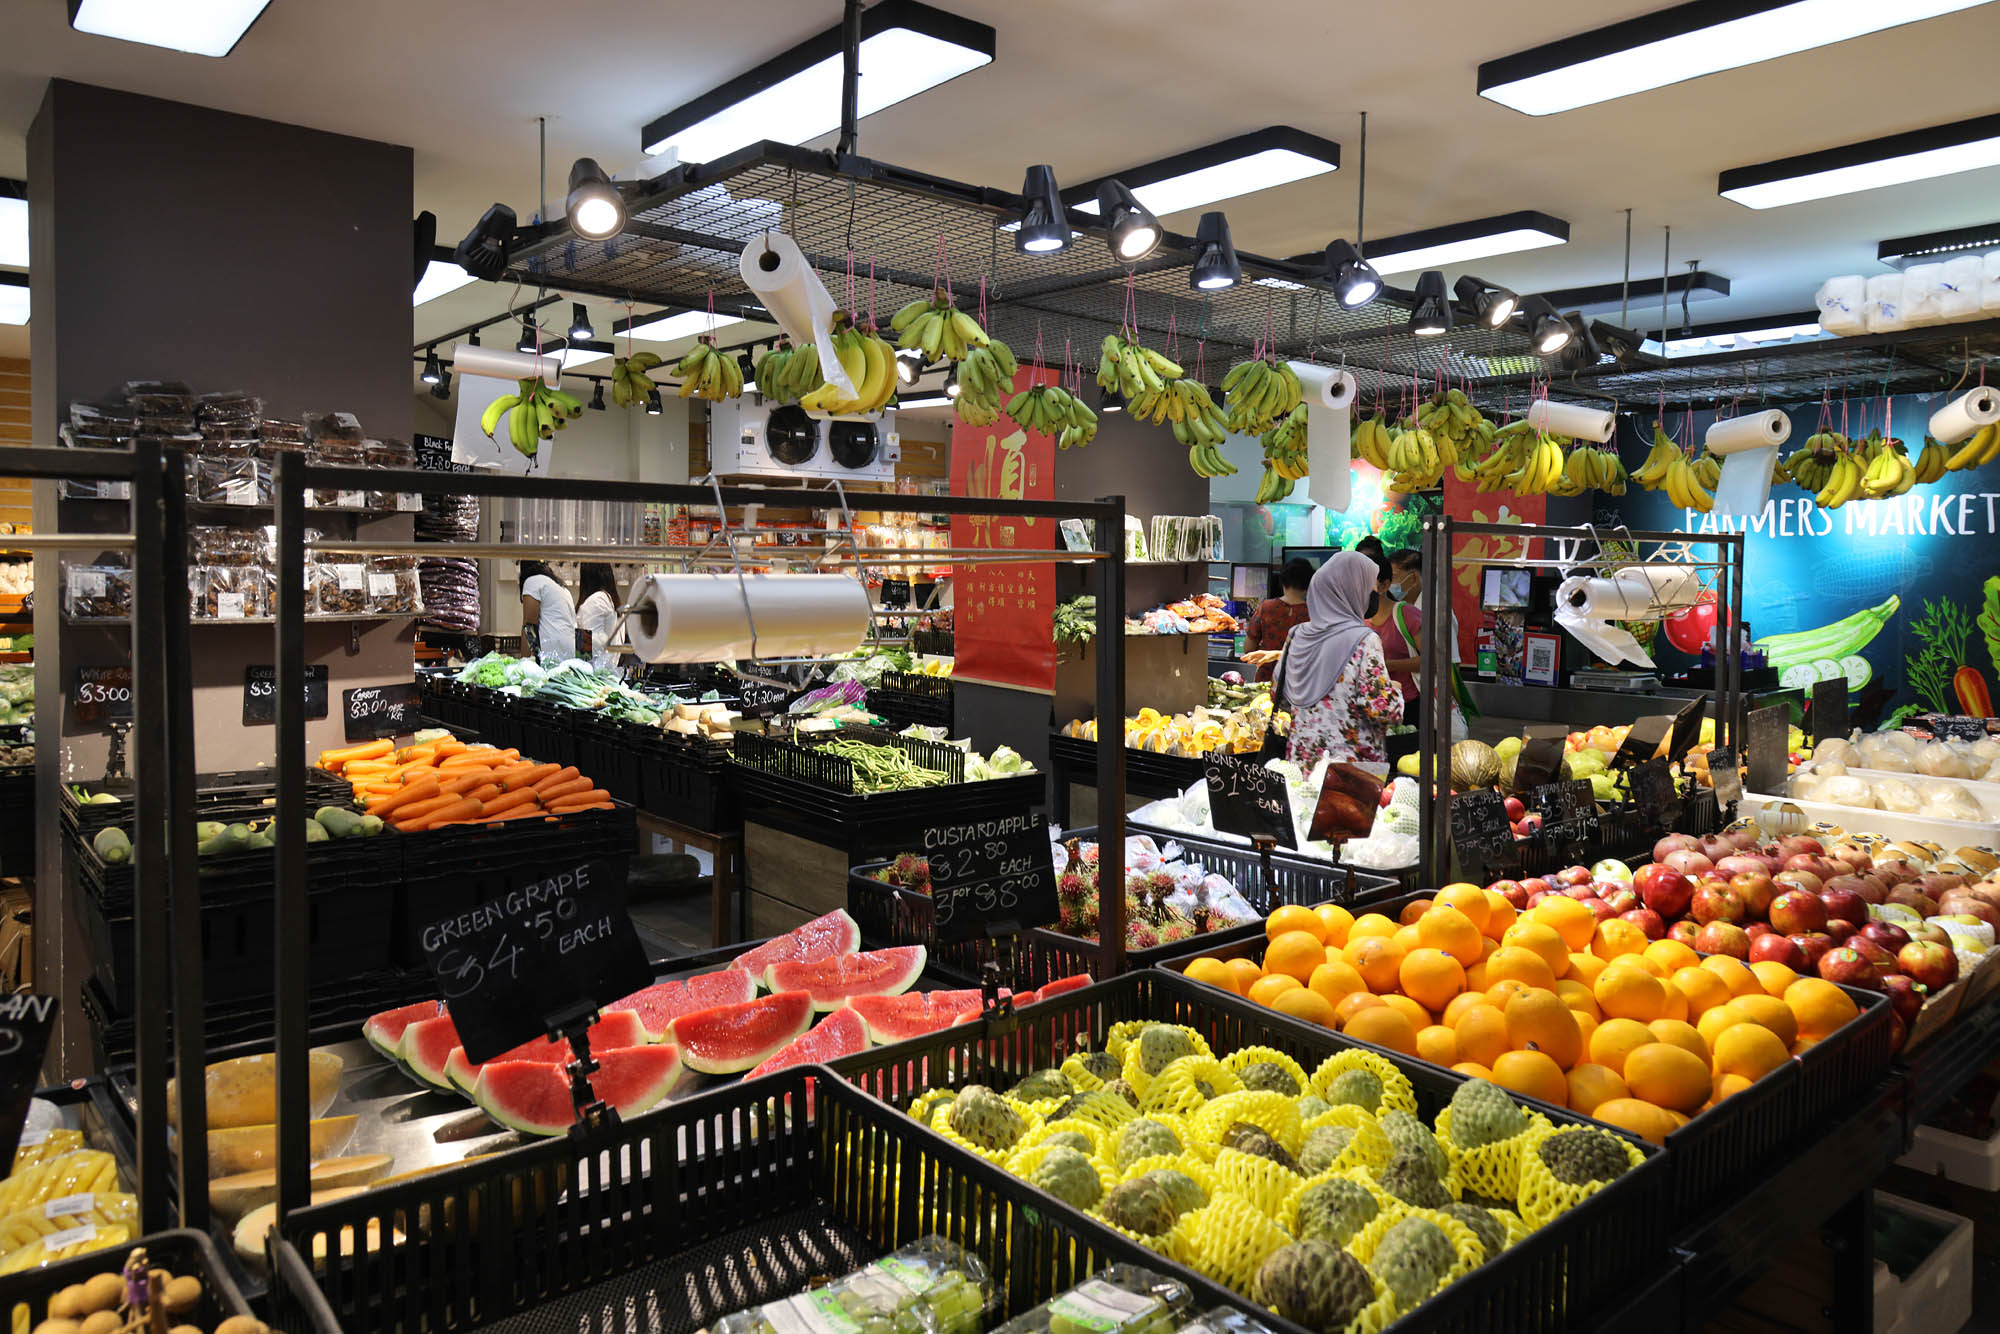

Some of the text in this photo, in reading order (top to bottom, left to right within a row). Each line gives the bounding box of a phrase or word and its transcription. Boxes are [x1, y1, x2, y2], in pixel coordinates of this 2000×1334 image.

[1845, 493, 2000, 536] MARKET
[1205, 767, 1267, 797] $1.50
[928, 841, 1008, 881] $2.80
[1000, 855, 1032, 875] EACH
[974, 873, 1040, 911] $8.00
[437, 899, 577, 998] $4.50
[559, 916, 612, 954] EACH
